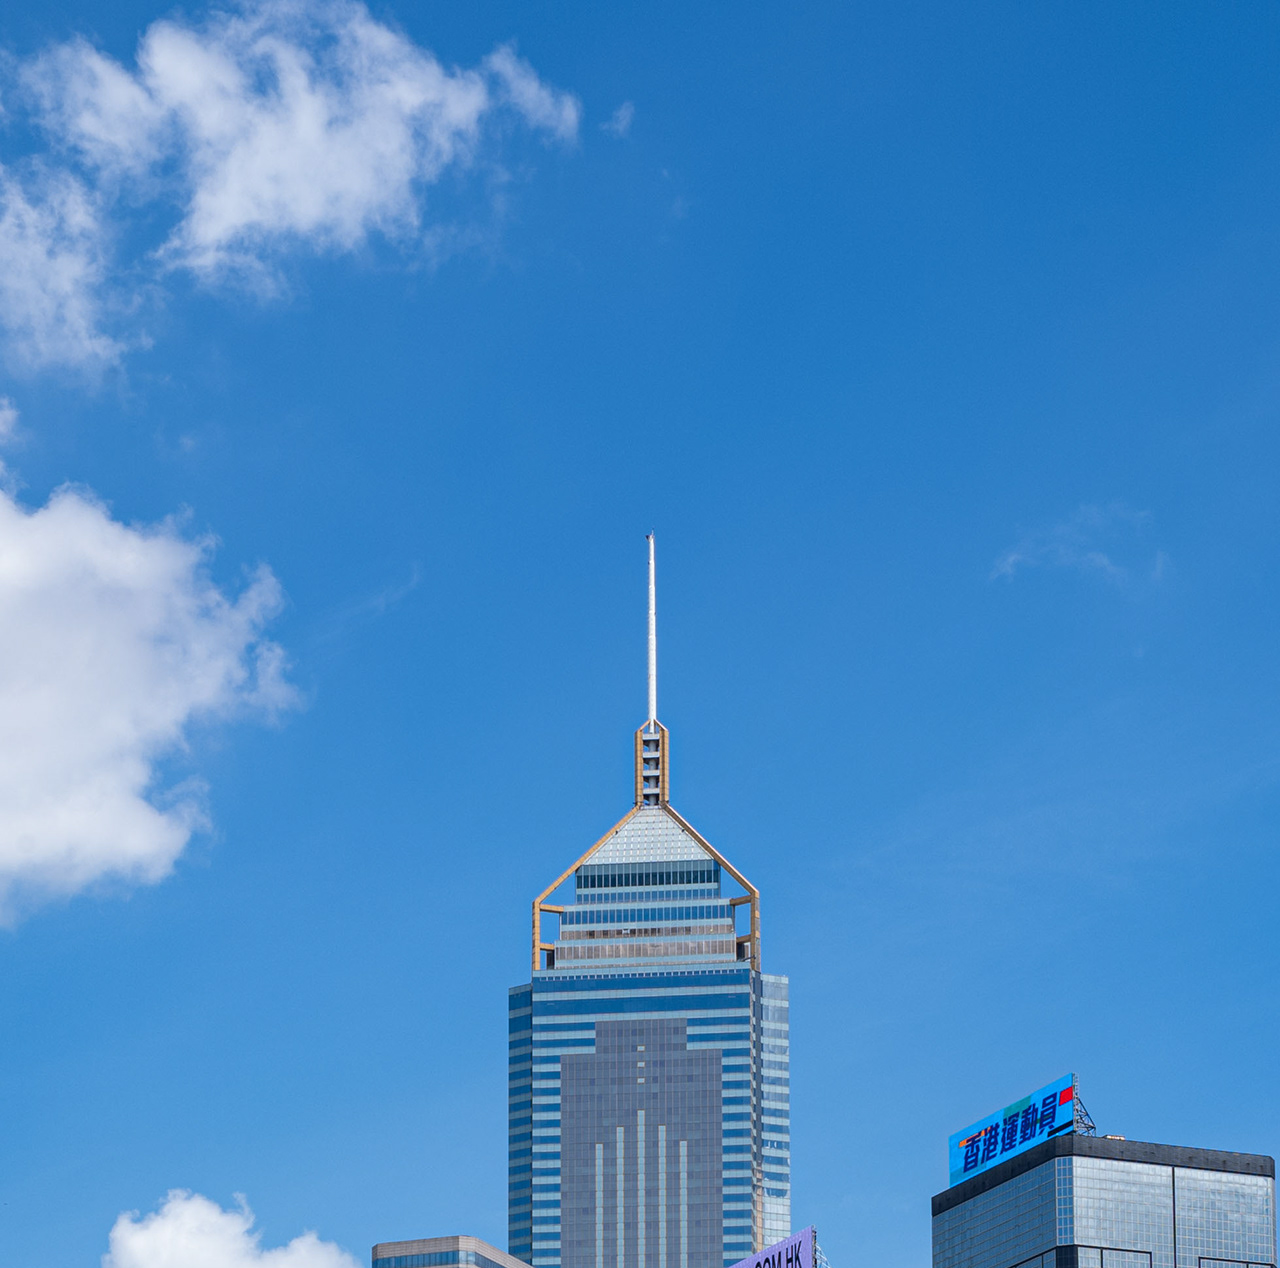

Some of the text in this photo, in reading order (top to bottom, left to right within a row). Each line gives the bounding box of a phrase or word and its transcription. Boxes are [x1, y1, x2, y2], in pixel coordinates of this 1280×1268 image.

[963, 1091, 1058, 1173] 香港運動員
